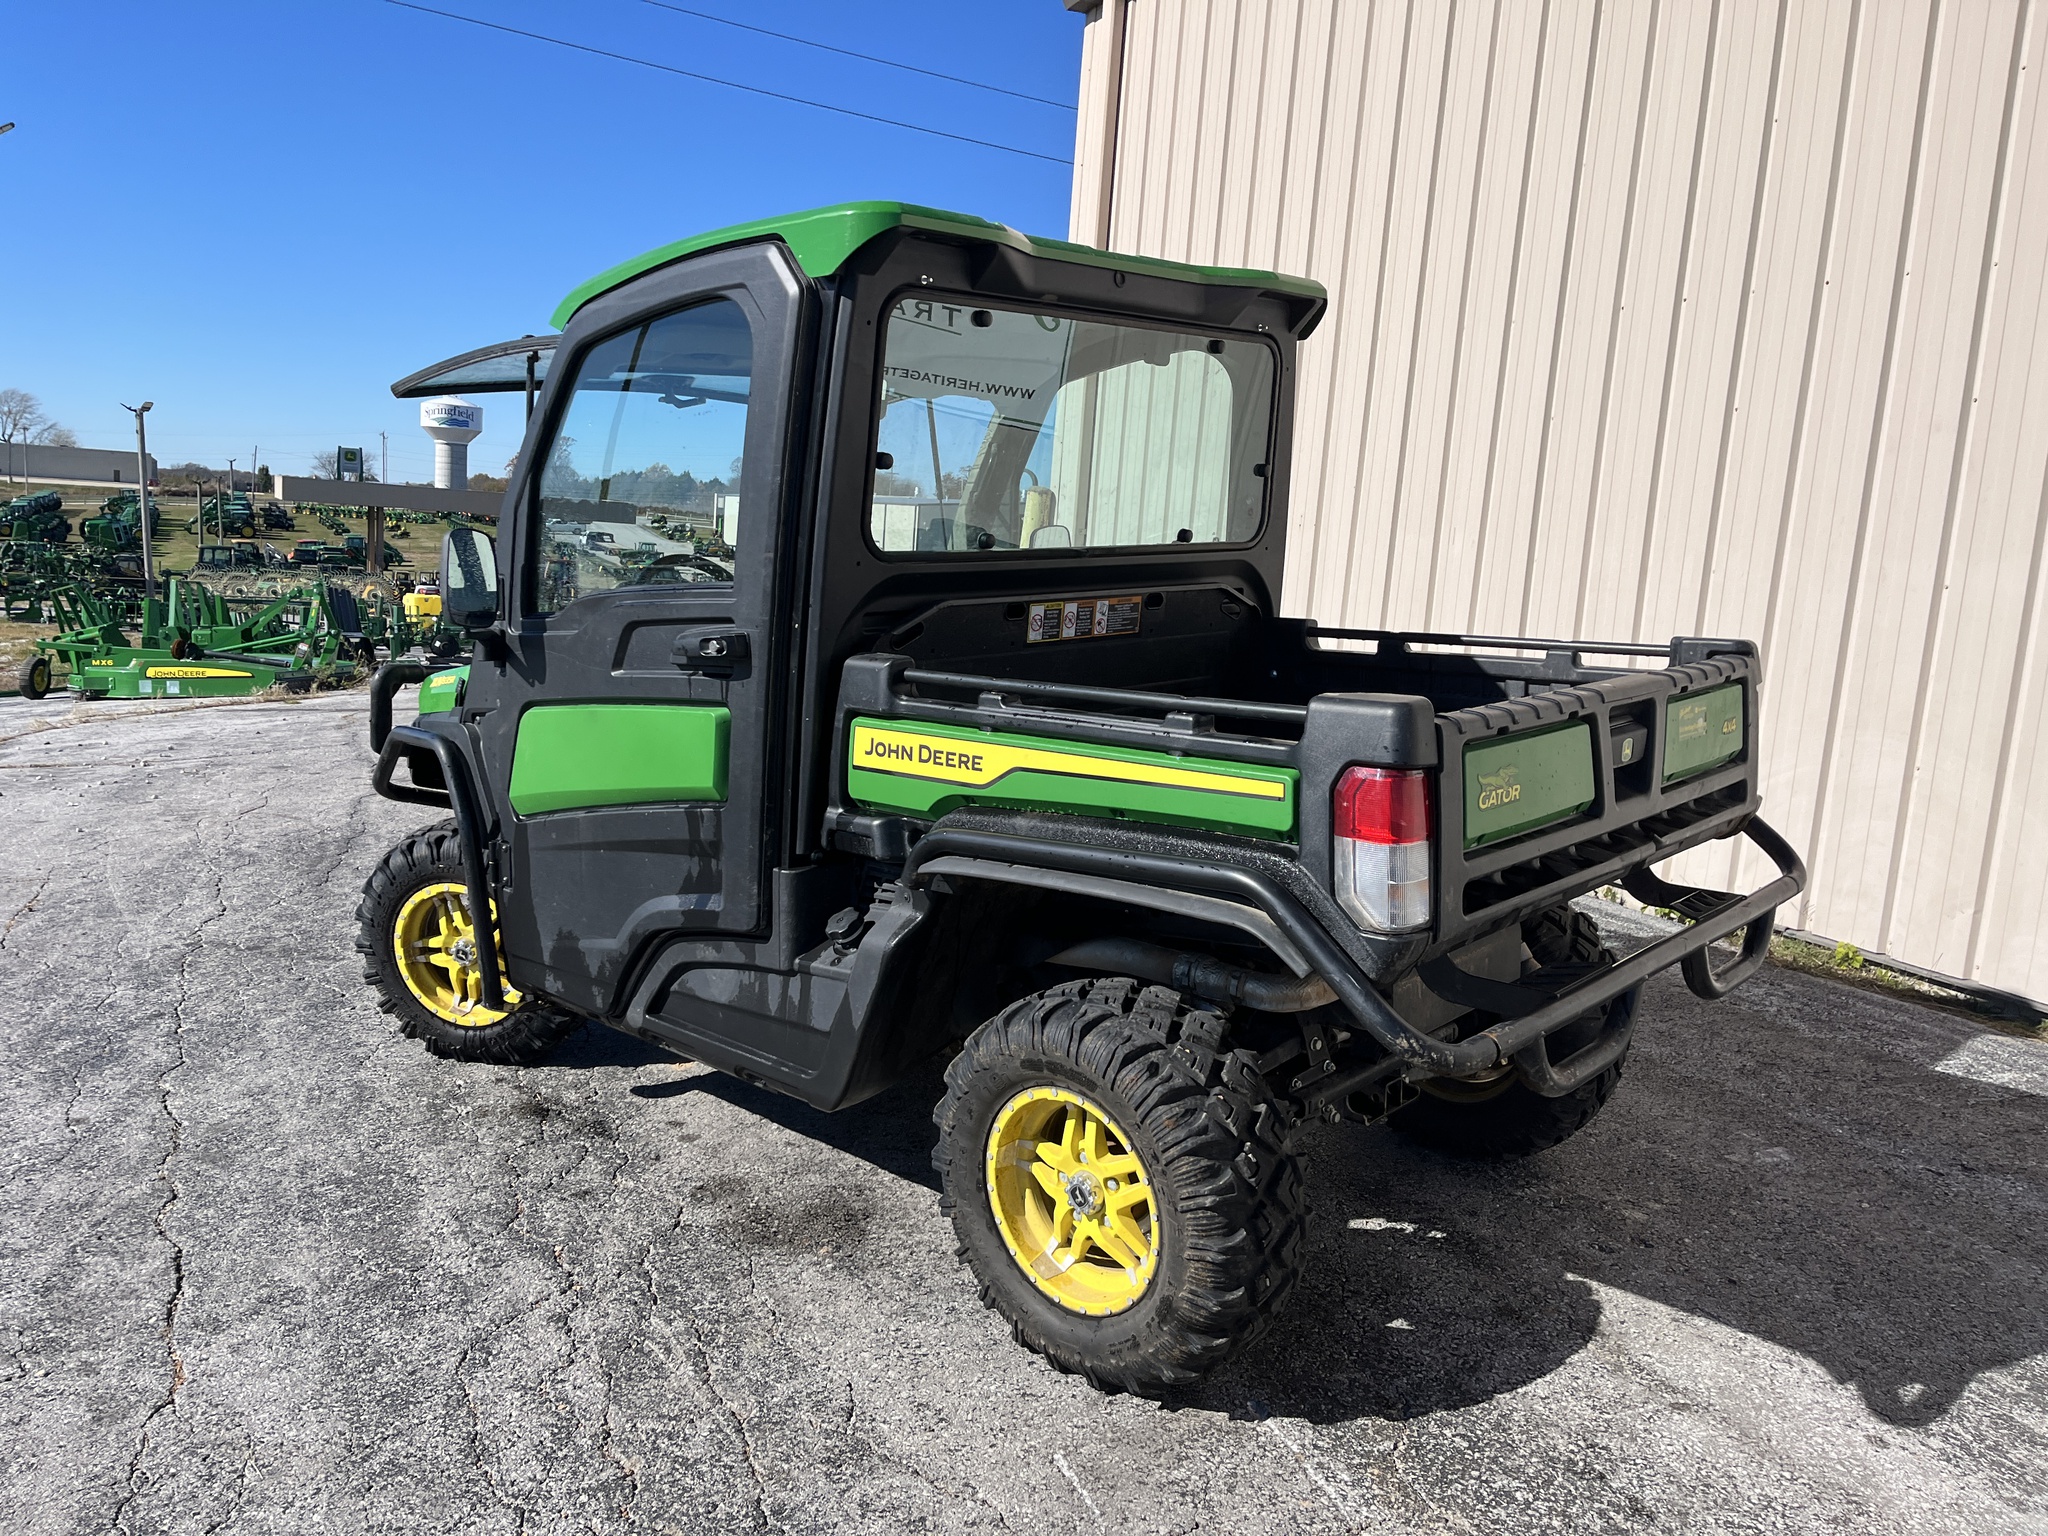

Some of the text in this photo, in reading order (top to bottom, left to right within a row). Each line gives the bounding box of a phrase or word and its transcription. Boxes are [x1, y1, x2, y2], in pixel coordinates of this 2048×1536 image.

[425, 405, 475, 422] Springfield
[865, 737, 983, 772] JOHN DEERE
[1479, 784, 1521, 810] GATOR
